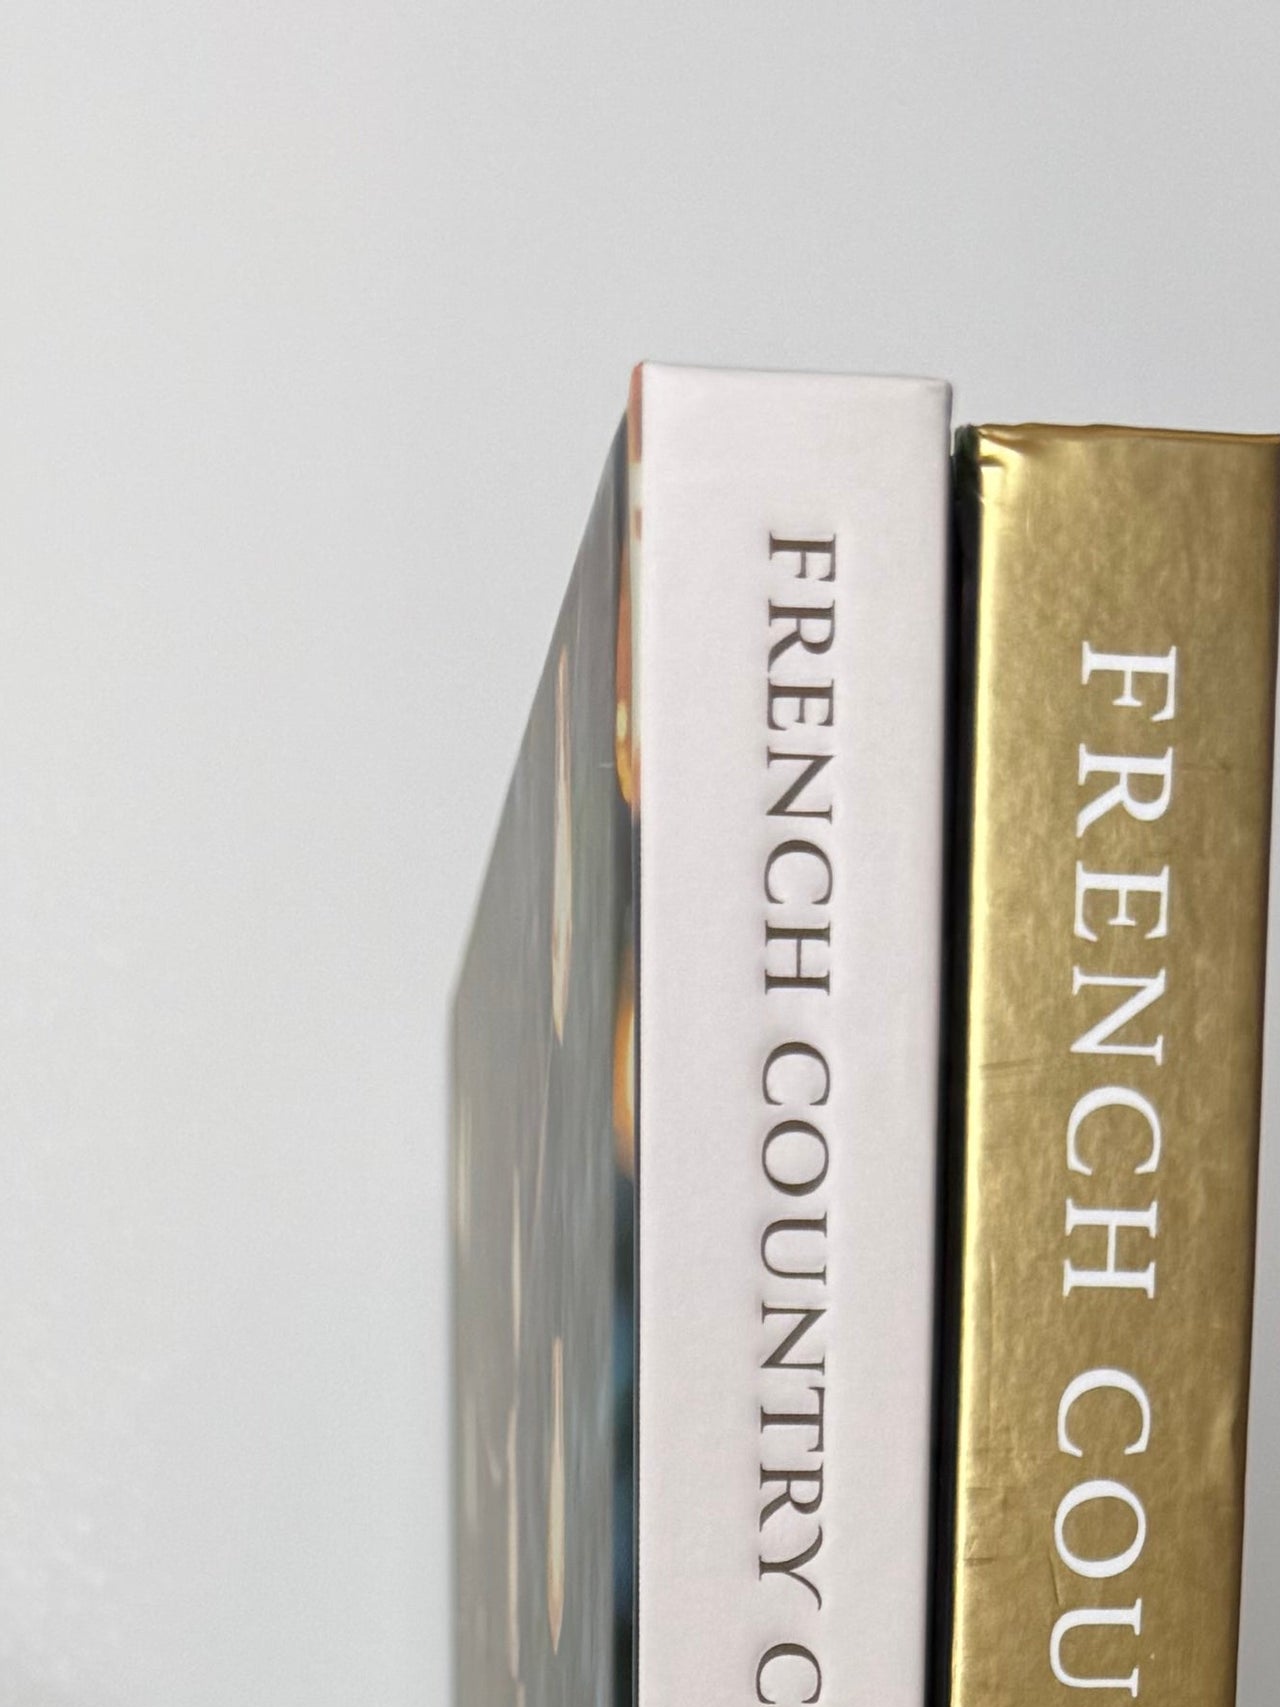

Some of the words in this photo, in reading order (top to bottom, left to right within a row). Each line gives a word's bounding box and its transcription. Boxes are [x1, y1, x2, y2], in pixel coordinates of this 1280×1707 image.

[763, 532, 836, 994] FRENCH
[1062, 641, 1177, 1299] FRENCH
[758, 1041, 831, 1610] COUNTRY
